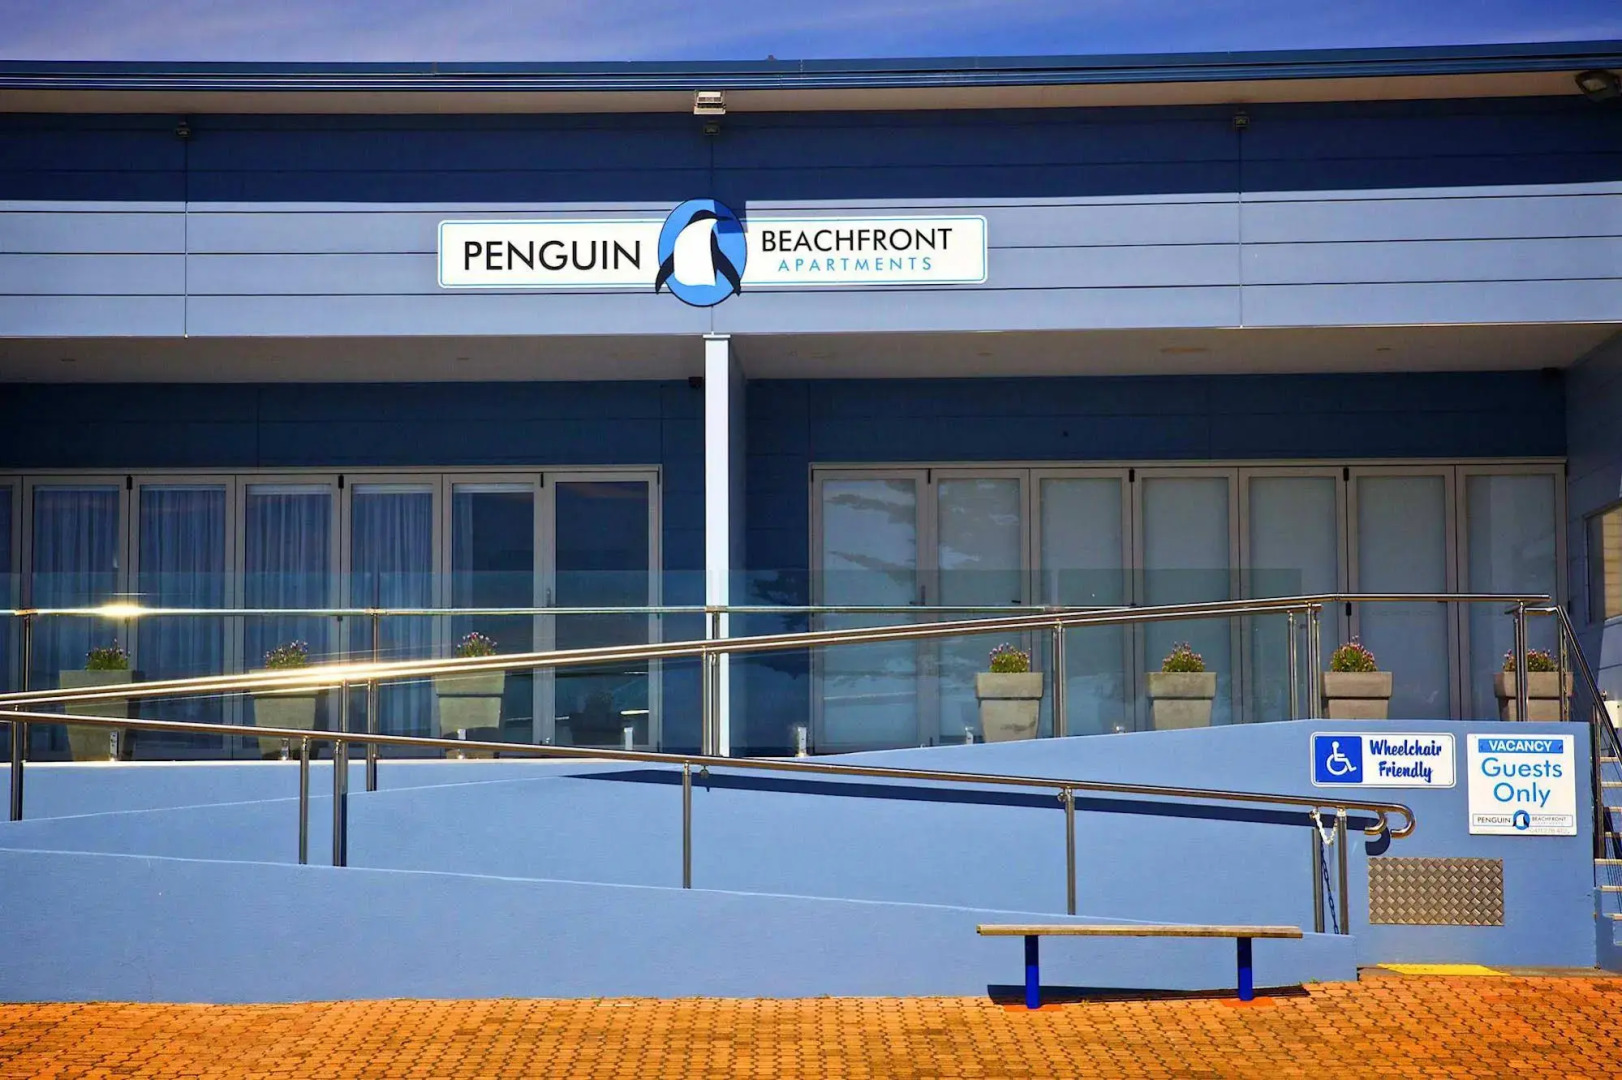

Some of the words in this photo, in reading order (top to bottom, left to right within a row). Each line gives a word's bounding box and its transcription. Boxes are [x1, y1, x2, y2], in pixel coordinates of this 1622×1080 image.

[761, 228, 952, 252] BEACHFRONT
[464, 240, 640, 271] PENGUIN
[777, 256, 932, 272] APARTMENTS
[1369, 739, 1442, 756] Wheelchair
[1488, 740, 1553, 752] VACANCY
[1378, 760, 1434, 783] Friendly
[1481, 756, 1563, 778] Guests
[1493, 781, 1551, 808] Only
[1477, 816, 1511, 824] PENGUIN
